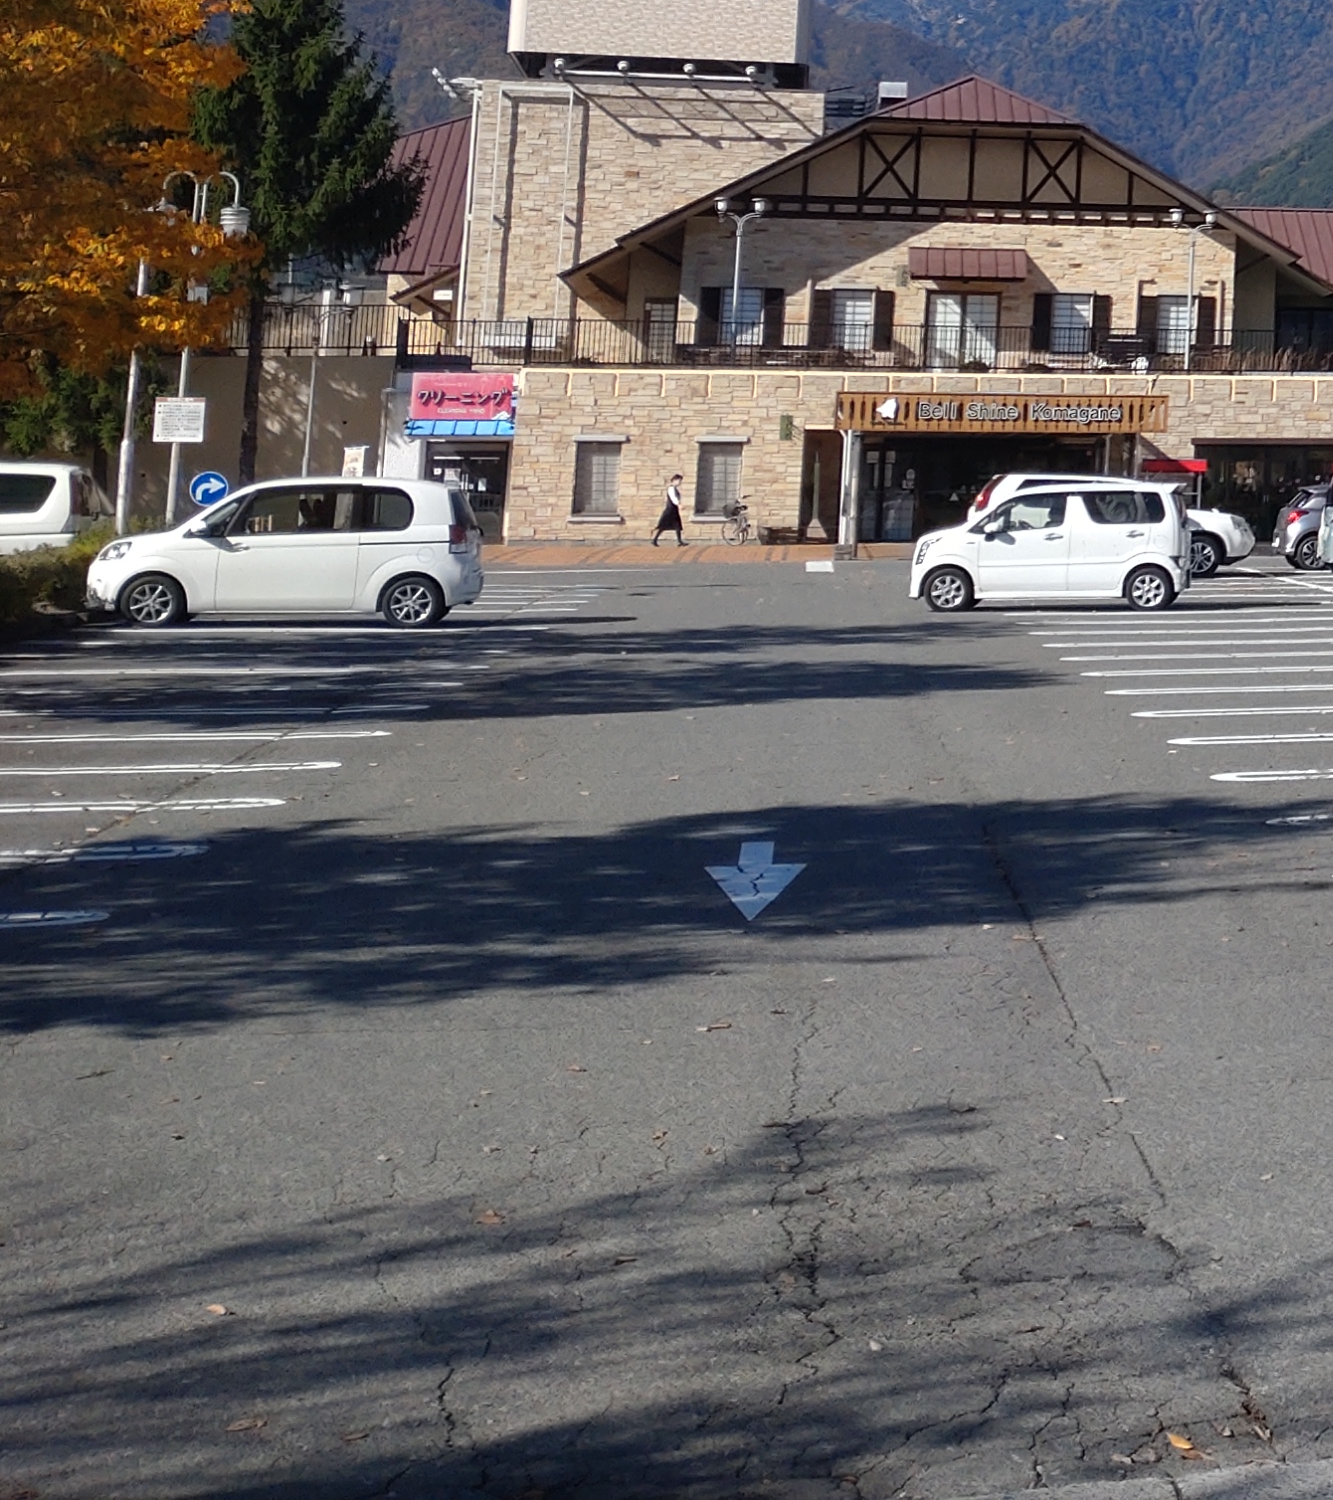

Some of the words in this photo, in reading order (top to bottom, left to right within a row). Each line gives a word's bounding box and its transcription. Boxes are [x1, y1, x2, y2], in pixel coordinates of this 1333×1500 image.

[418, 387, 509, 406] クリーニング
[918, 402, 957, 420] Bell
[966, 403, 1020, 421] Shine
[1031, 403, 1122, 425] Komagane
